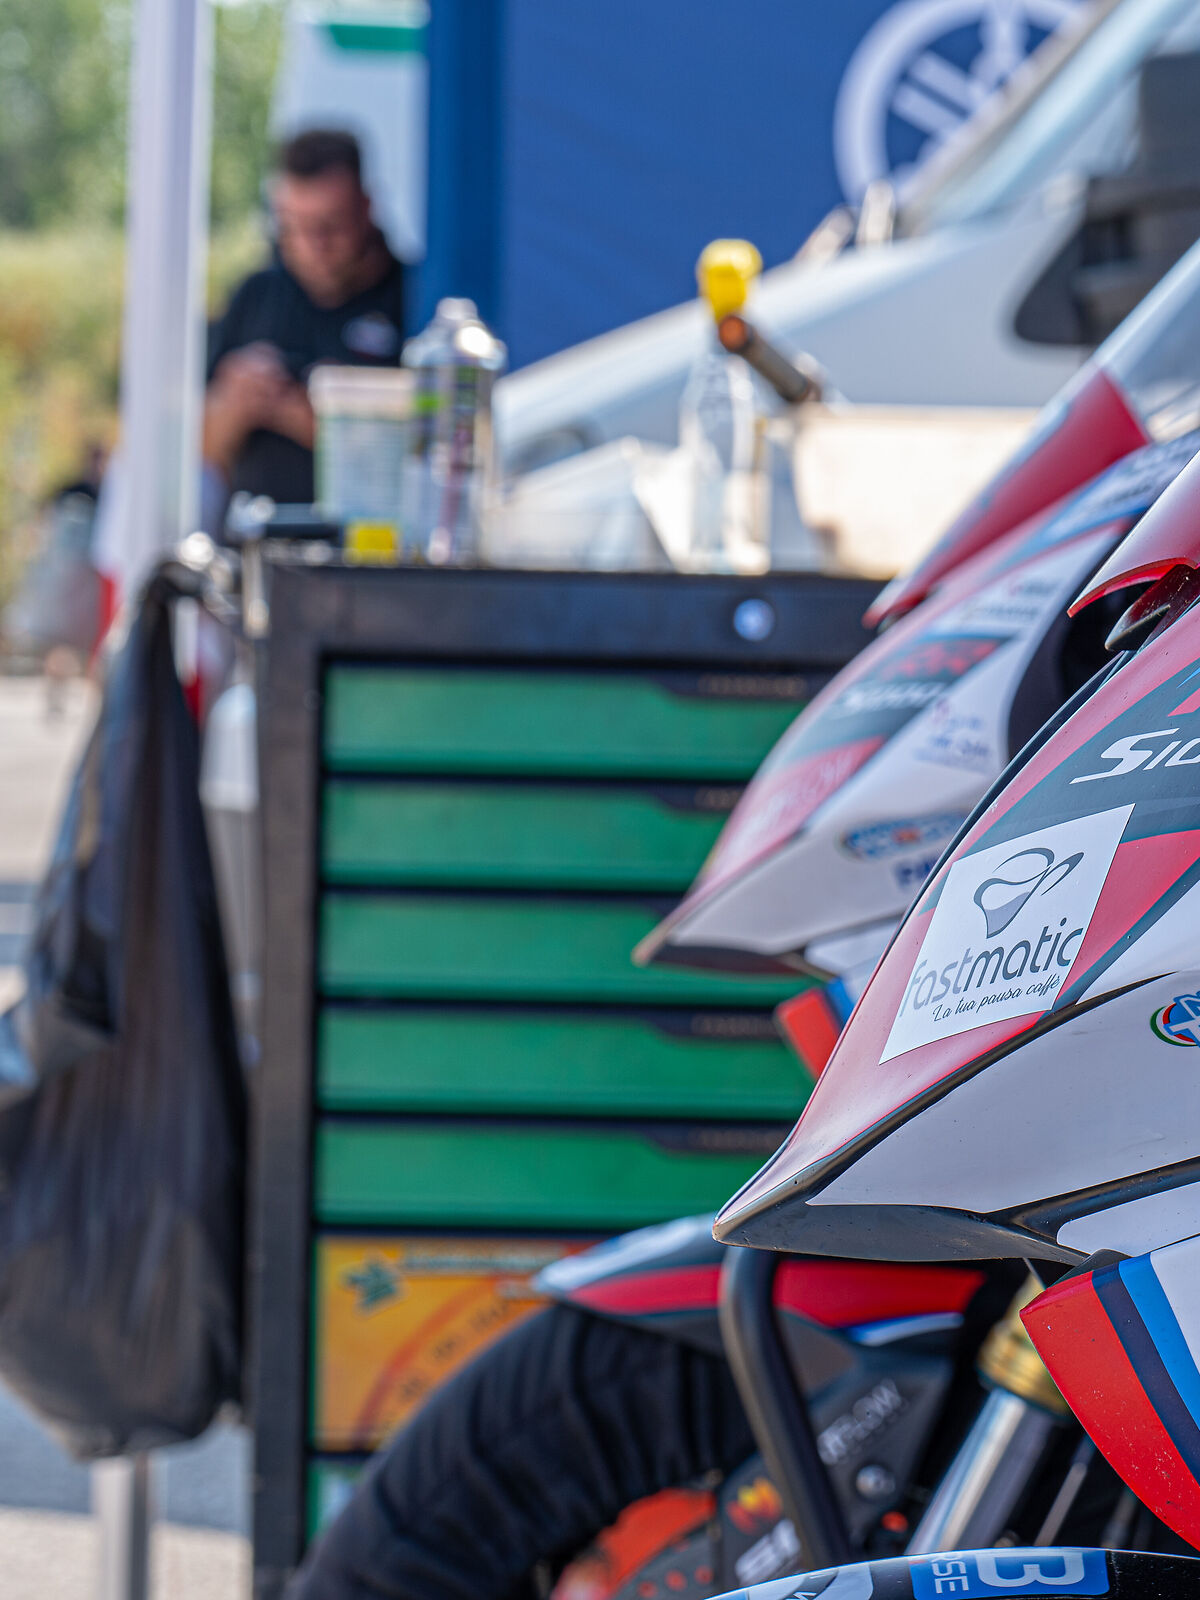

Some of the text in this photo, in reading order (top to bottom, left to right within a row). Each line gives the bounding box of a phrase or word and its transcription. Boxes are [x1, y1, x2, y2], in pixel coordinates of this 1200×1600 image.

[899, 917, 1084, 1018] fastmatic
[932, 1004, 952, 1022] La
[954, 996, 977, 1015] tua
[975, 986, 1023, 1014] pausa
